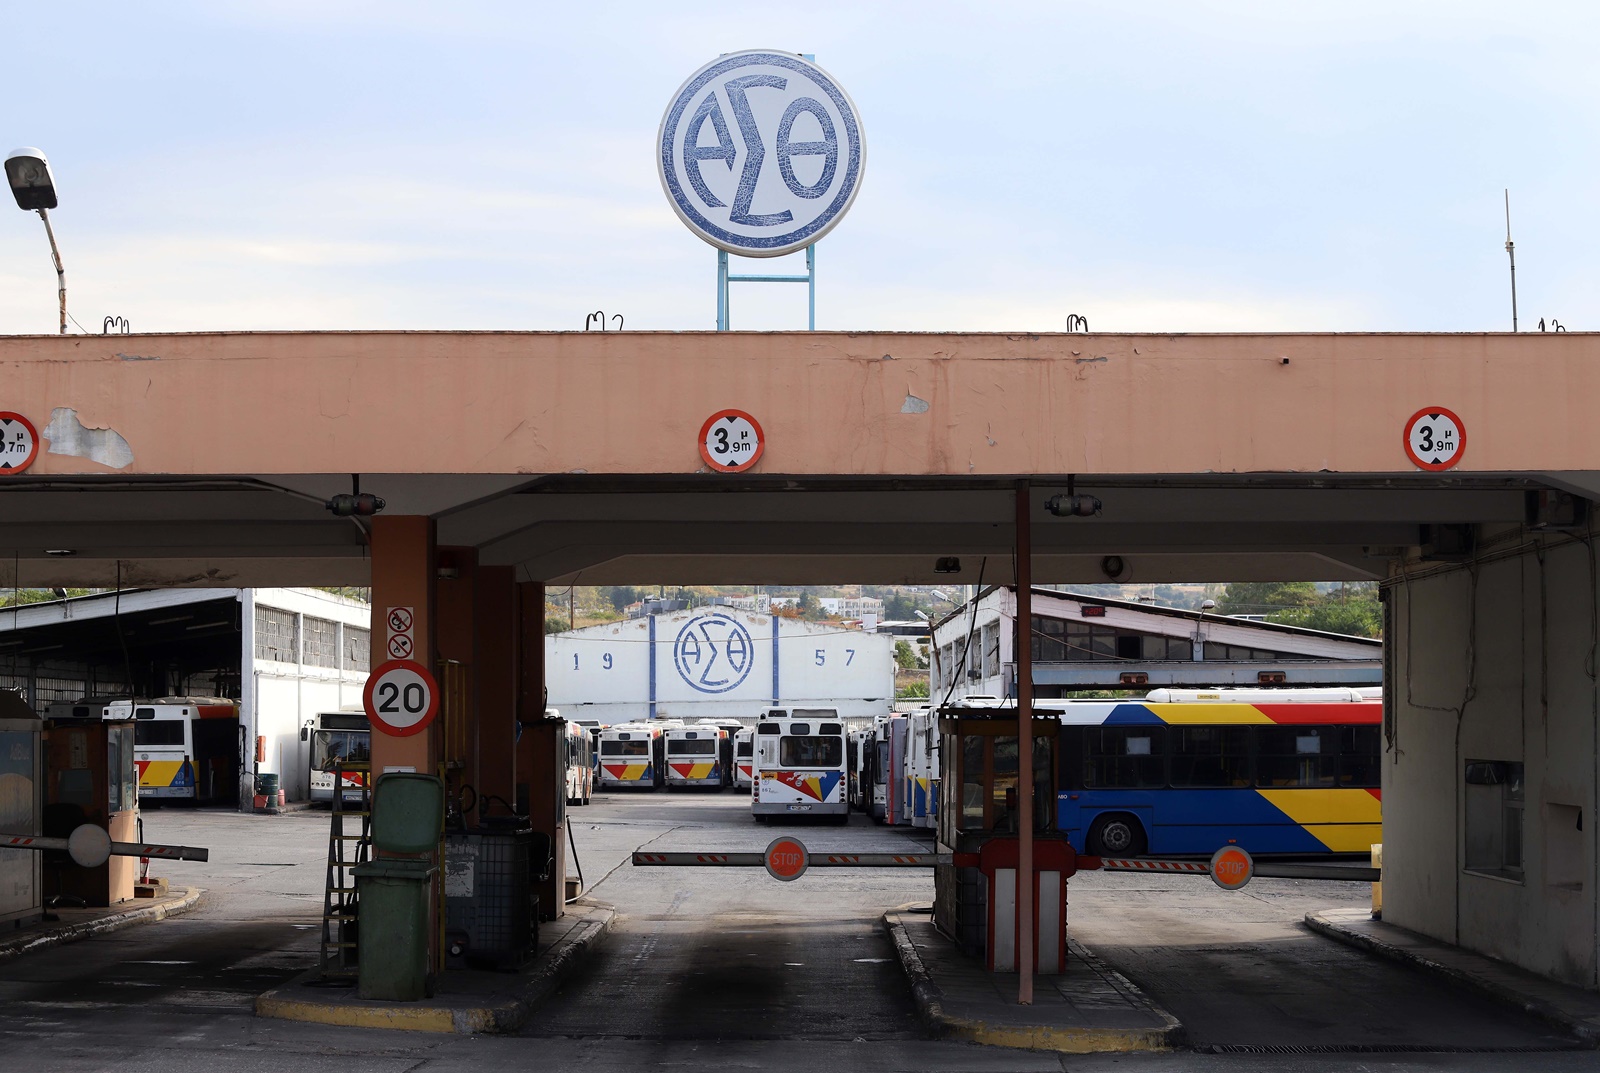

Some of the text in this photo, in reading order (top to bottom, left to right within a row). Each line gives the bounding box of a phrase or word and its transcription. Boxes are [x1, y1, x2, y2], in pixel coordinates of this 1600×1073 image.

[379, 682, 424, 713] 20
[772, 852, 801, 866] STOP
[1218, 861, 1246, 875] STOP
